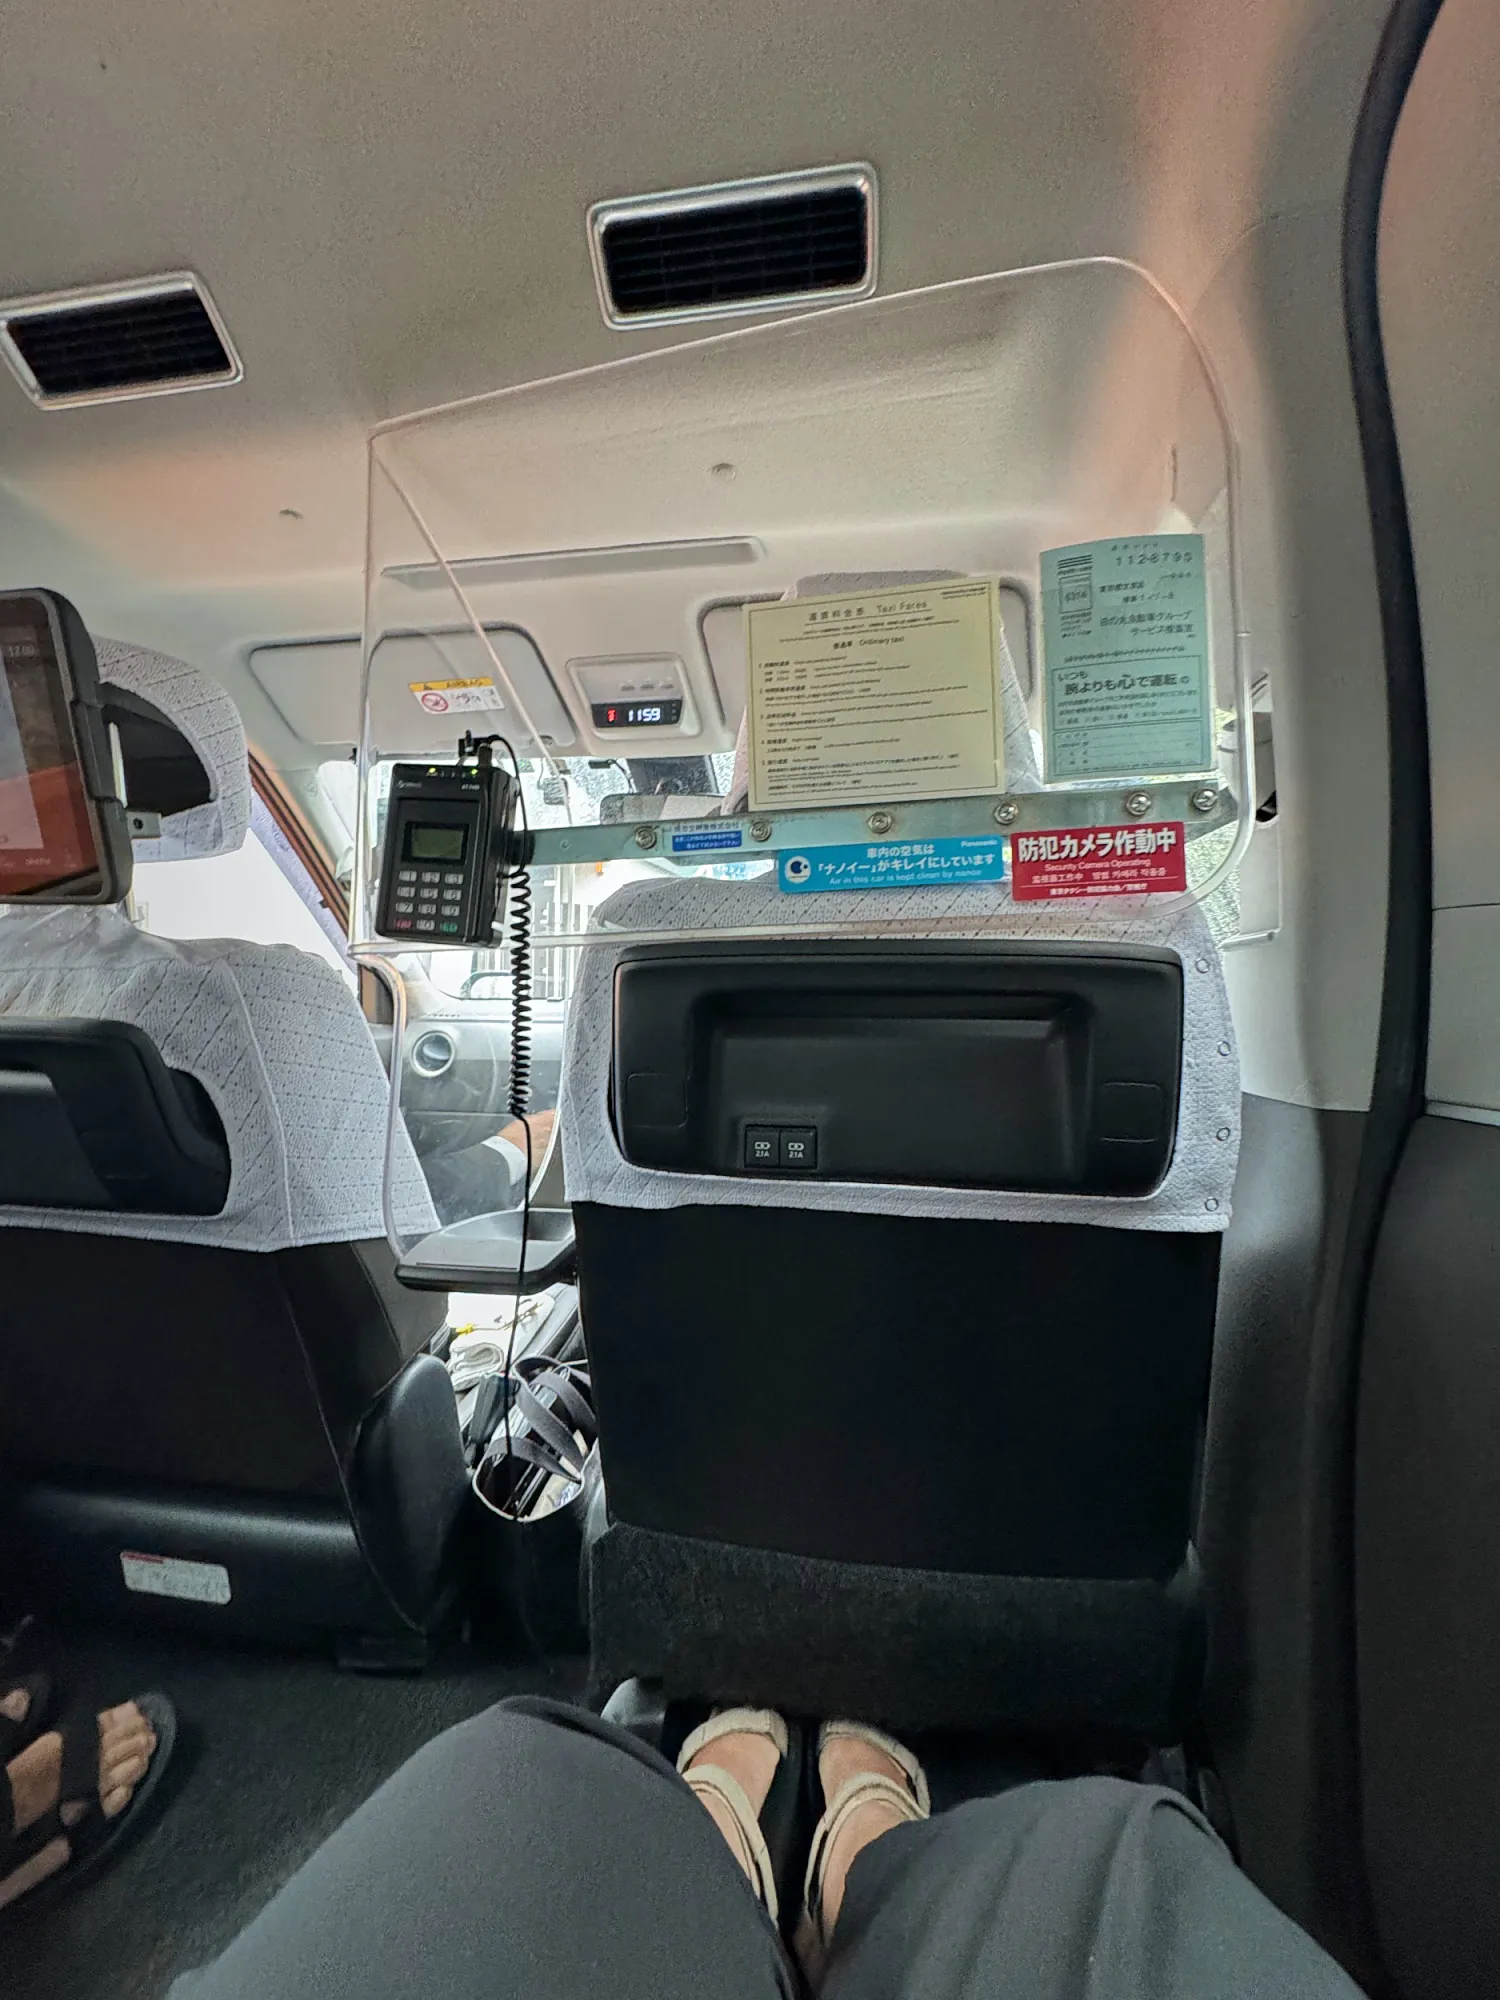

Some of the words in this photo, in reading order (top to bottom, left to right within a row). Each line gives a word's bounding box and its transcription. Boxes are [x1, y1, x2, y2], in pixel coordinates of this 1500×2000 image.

[876, 602, 896, 614] Taxi
[899, 600, 928, 611] Fares
[1058, 671, 1088, 681] いつも
[961, 840, 998, 848] Panasonic
[1018, 827, 1177, 863] 防犯カメラ作動中
[866, 844, 935, 859] 車内の空気は
[1044, 863, 1077, 873] Security
[1078, 861, 1110, 870] Camera
[1110, 858, 1152, 868] Operating
